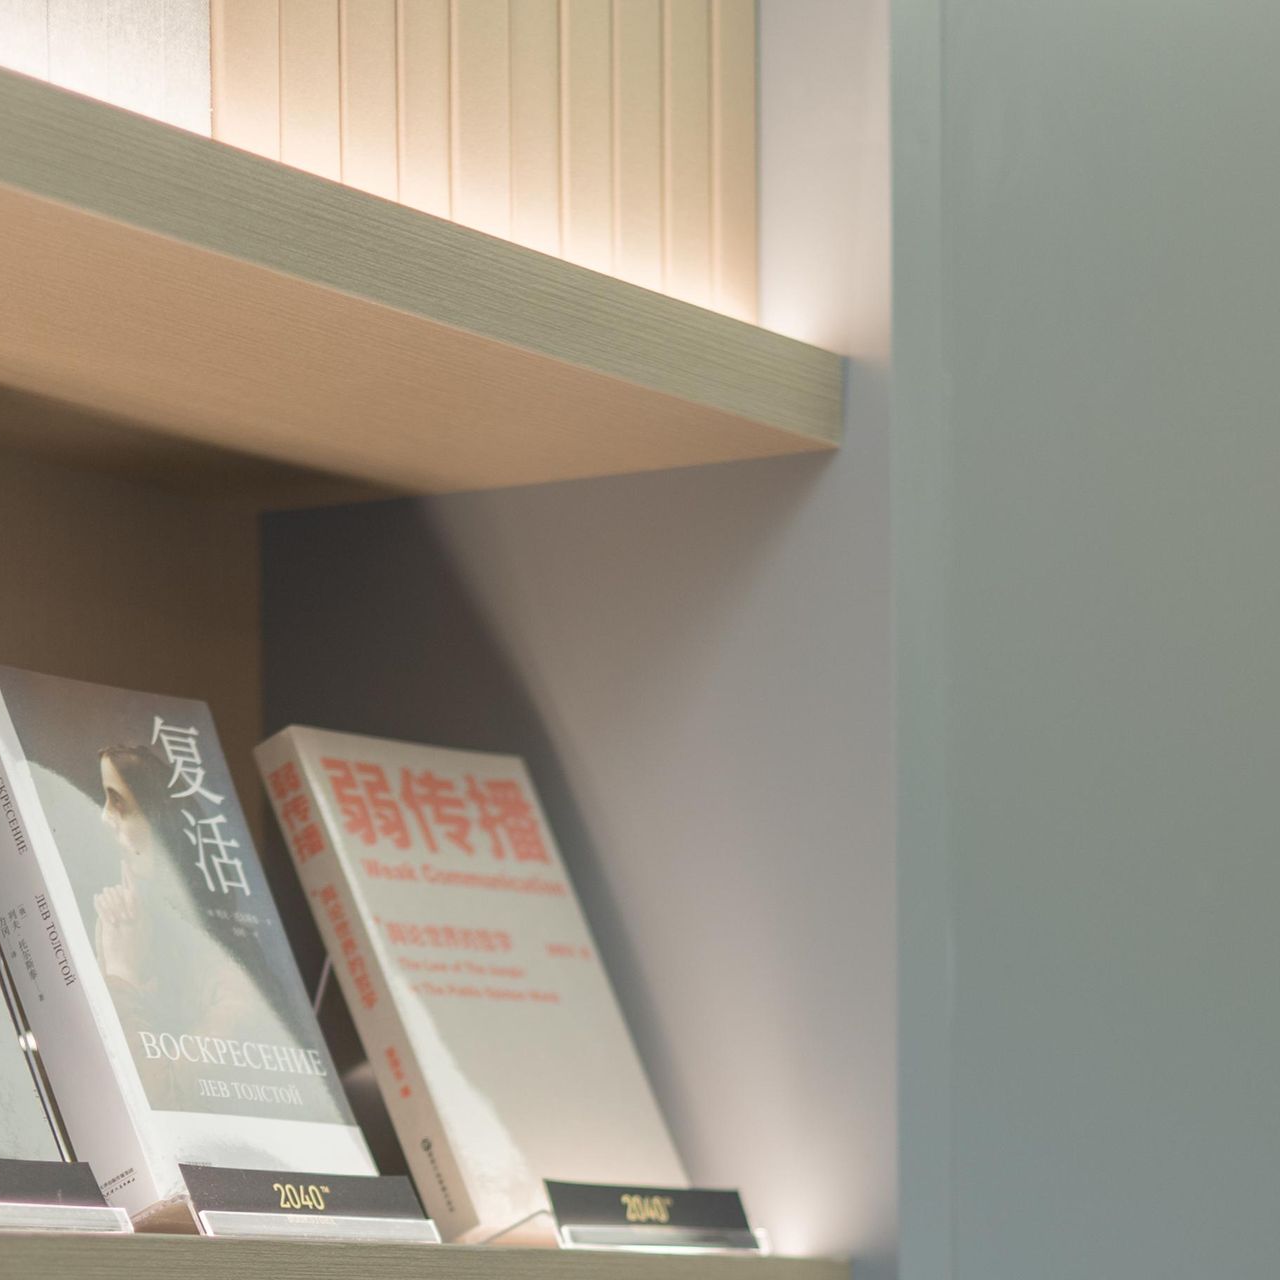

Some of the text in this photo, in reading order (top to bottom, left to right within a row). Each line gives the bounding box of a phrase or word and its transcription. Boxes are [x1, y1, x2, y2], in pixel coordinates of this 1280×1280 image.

[150, 715, 252, 898] 复活
[320, 757, 552, 865] 弱传播
[35, 894, 77, 987] ЛЕВ ТОЛСТОЙ
[139, 1031, 327, 1077] ВОСКРЕСЕНИЕ
[198, 1079, 304, 1105] ЛЕВ ТОЛСТОЙ
